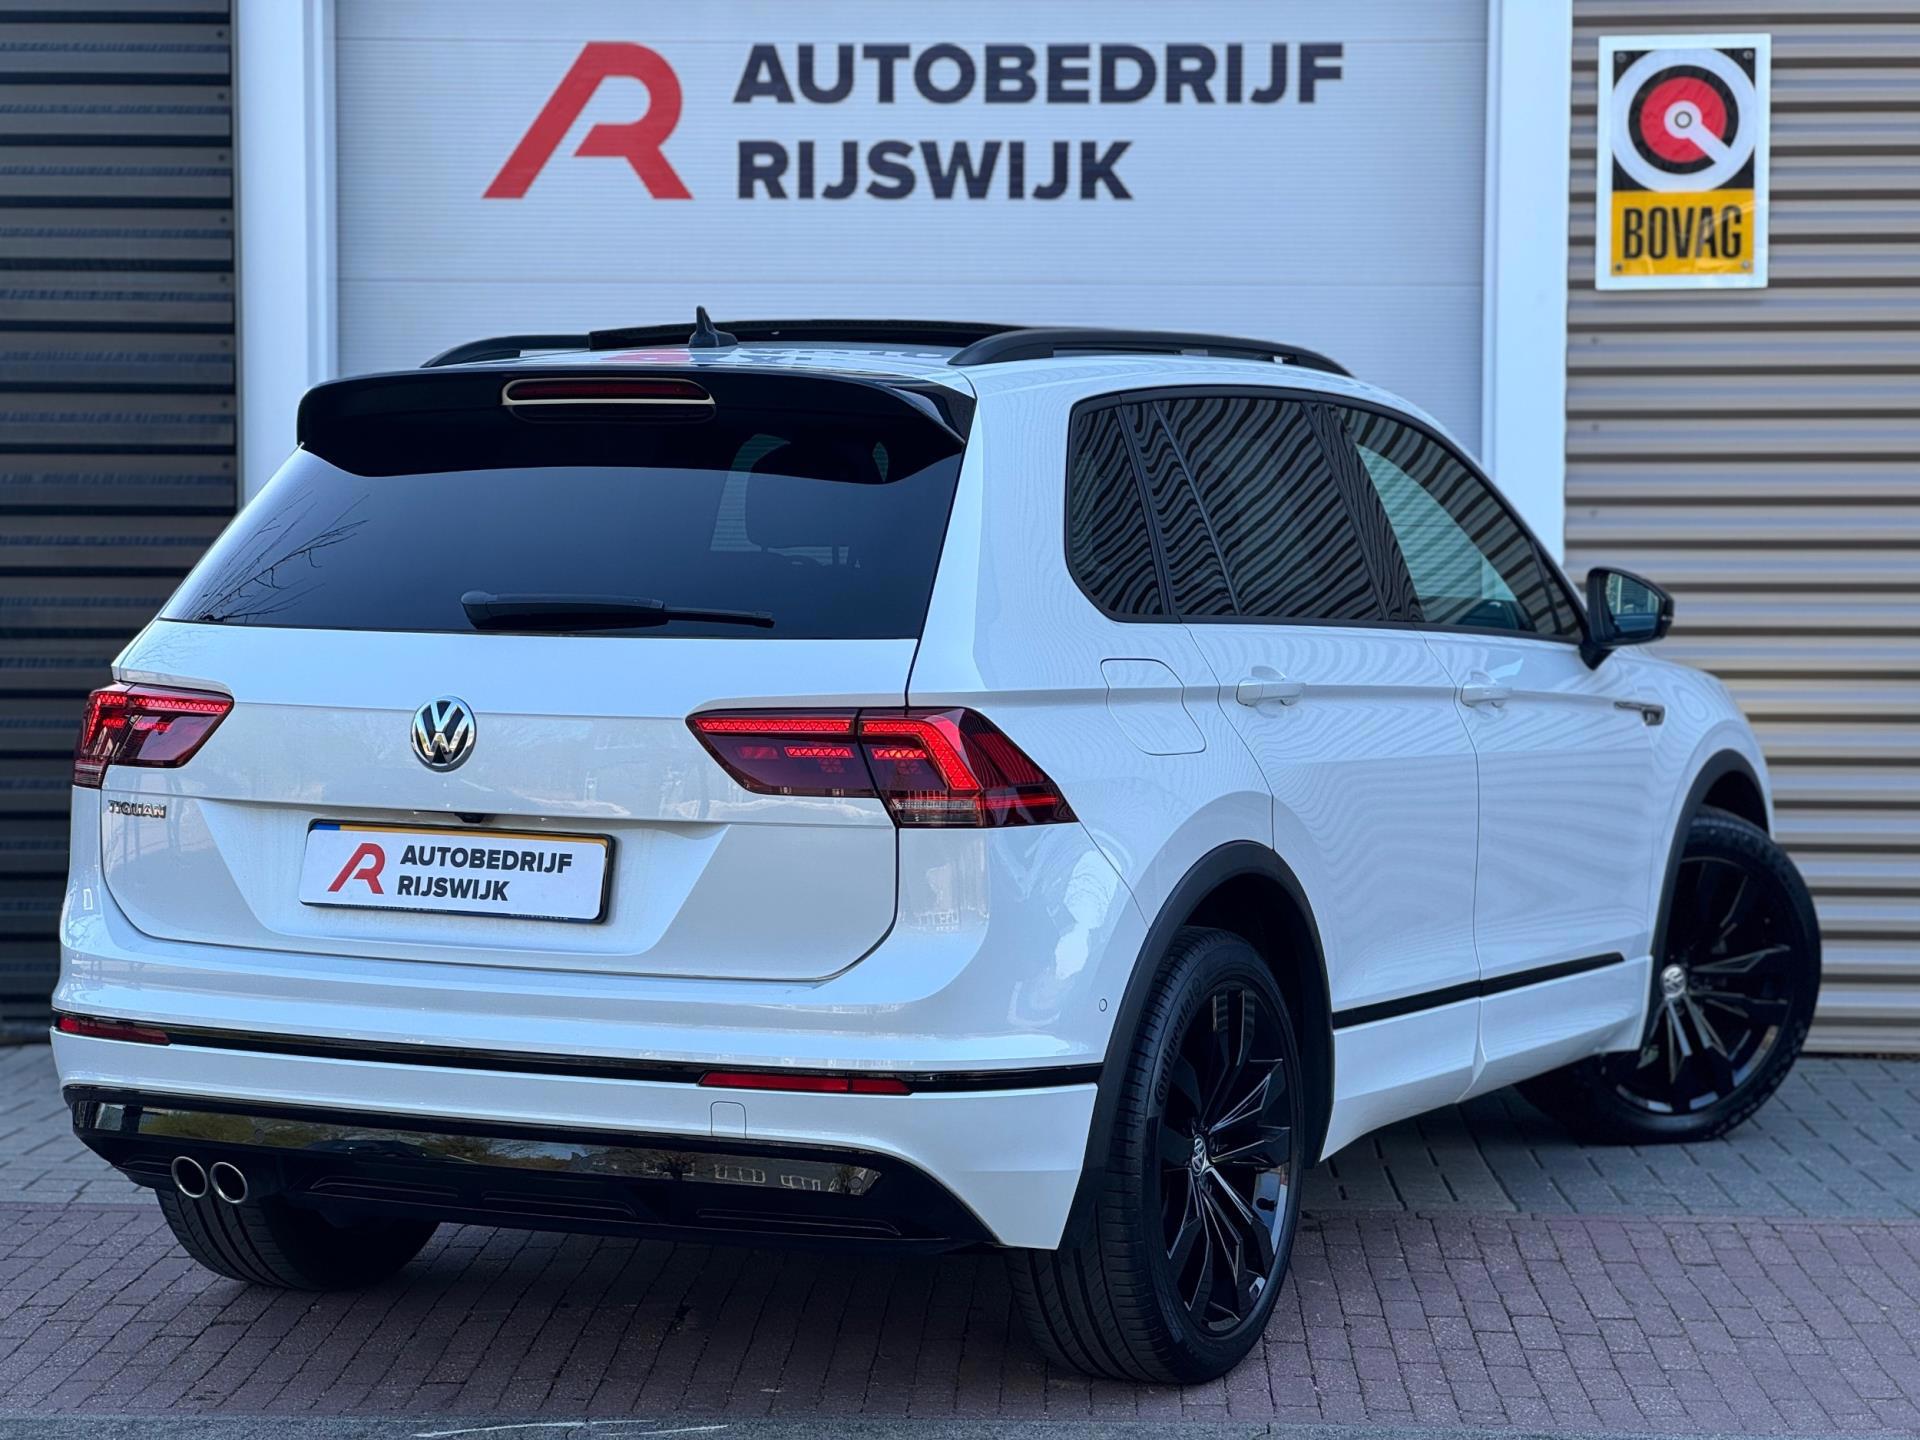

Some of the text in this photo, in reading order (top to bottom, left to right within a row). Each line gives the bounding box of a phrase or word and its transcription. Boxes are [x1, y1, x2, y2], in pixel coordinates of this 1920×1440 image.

[733, 43, 1344, 104] AUTOBEDRIJF
[737, 140, 1134, 200] RIJSWIJK
[1622, 205, 1743, 260] BOVAG
[399, 845, 573, 874] AUTOBEDRIJF
[396, 875, 511, 902] RIJSWIJK
